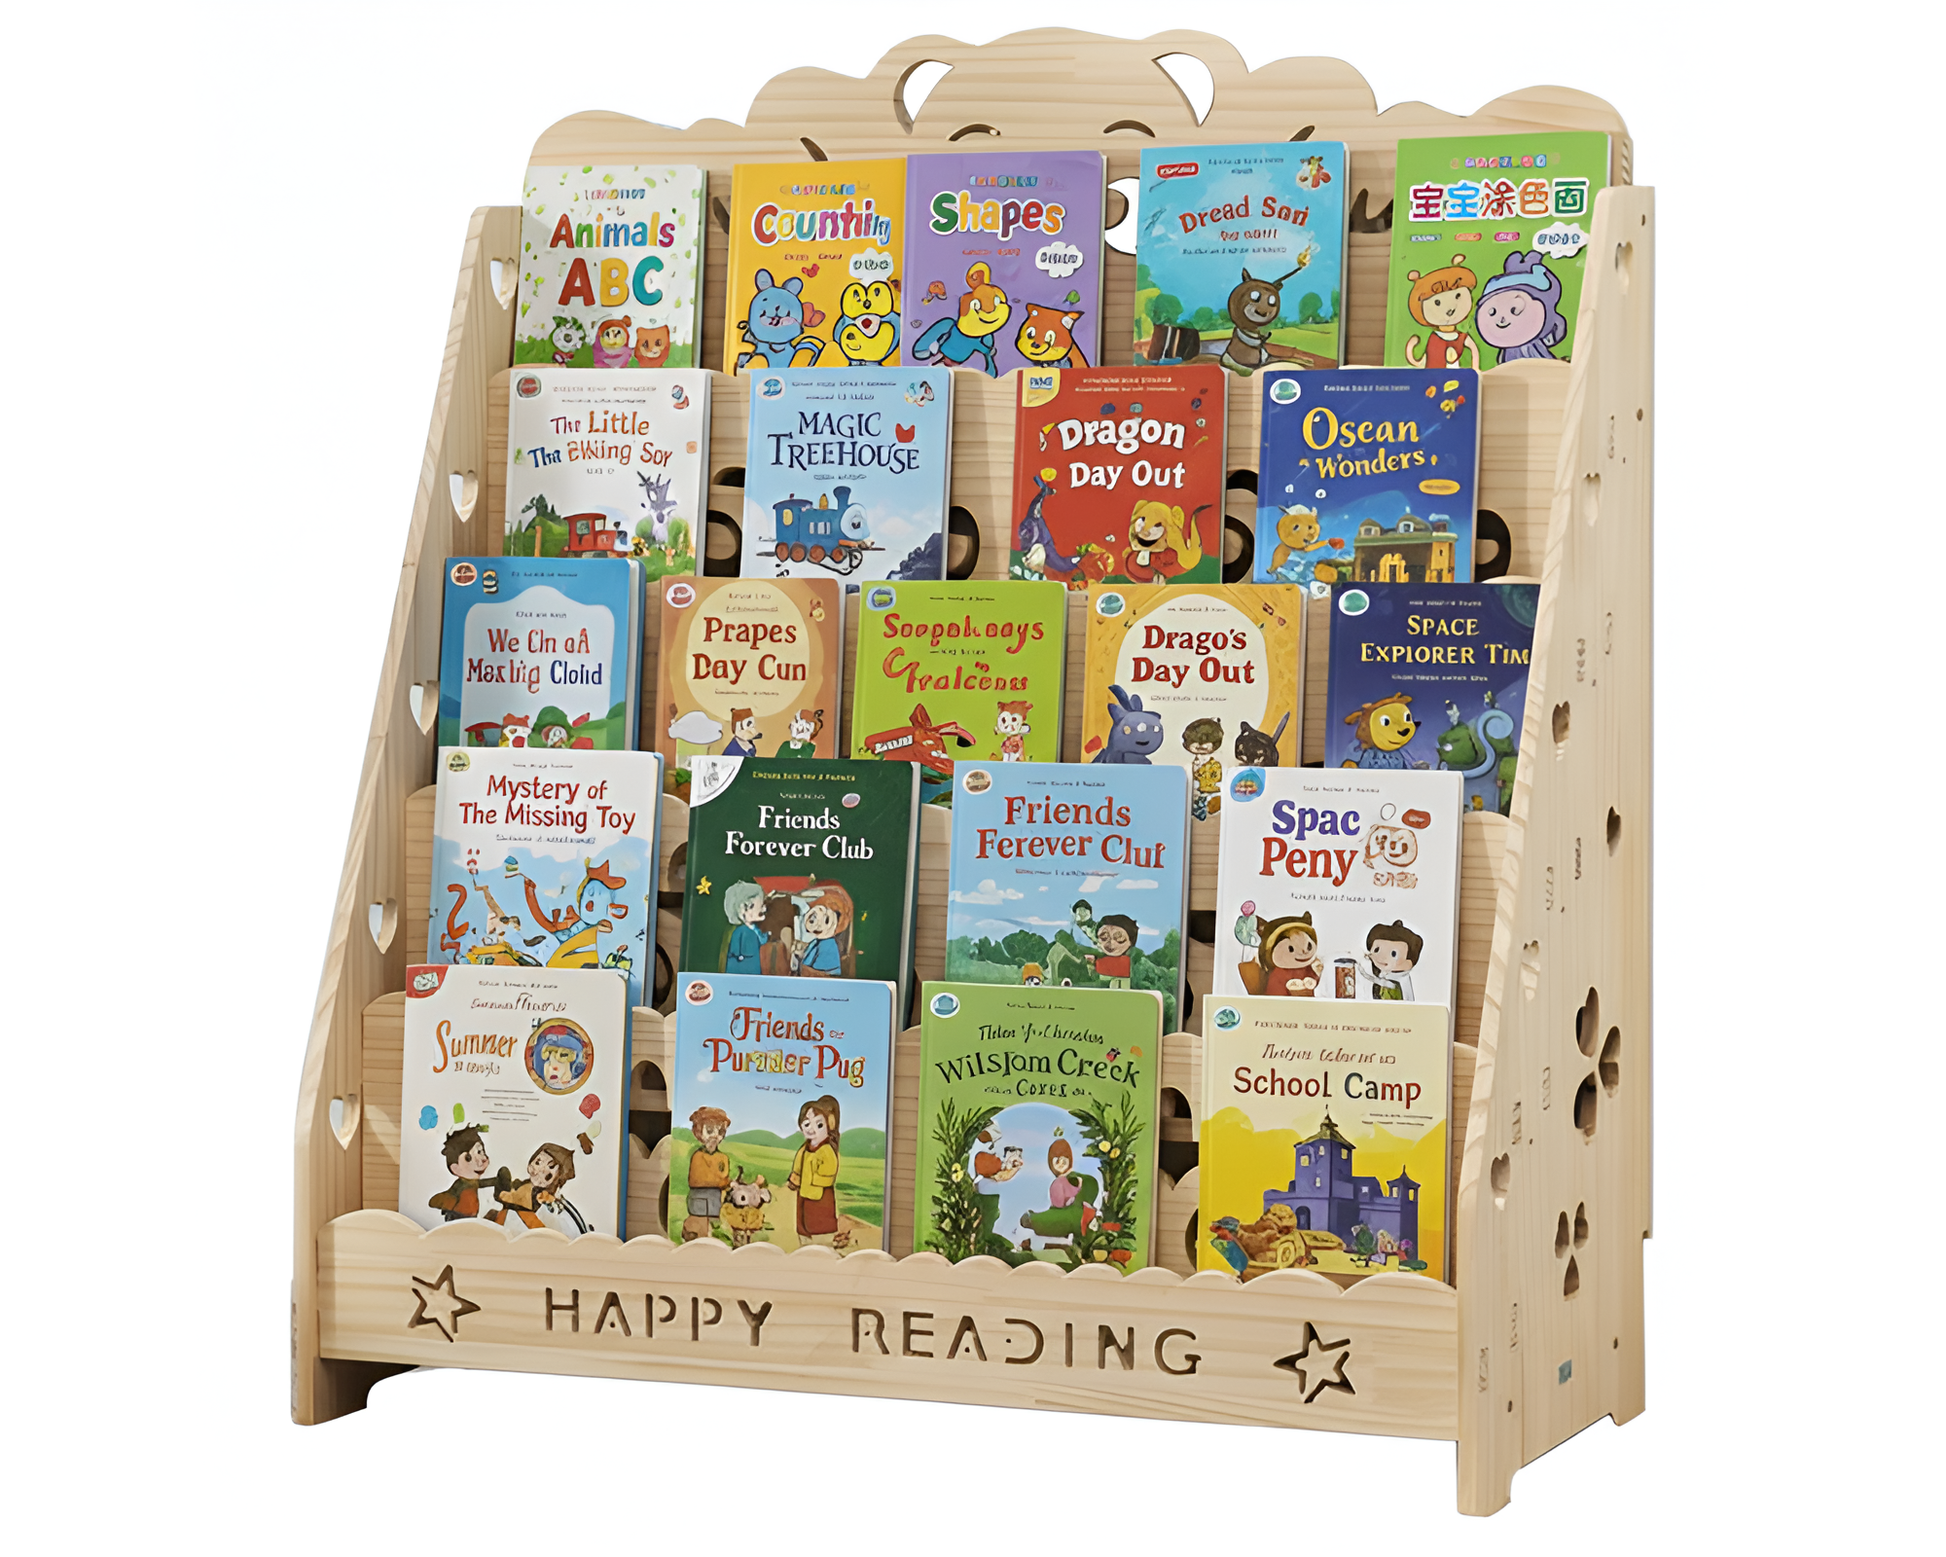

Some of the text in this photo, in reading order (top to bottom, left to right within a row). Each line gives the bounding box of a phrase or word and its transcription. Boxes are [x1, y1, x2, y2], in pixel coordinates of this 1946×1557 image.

[549, 211, 676, 248] Animals
[929, 190, 1067, 241] Shapes
[1178, 195, 1250, 234] Dread
[558, 255, 664, 307] ABC
[587, 409, 650, 436] Little
[798, 411, 882, 439] MAGIC
[1056, 417, 1186, 455] Dragon
[1302, 406, 1420, 450] Osean
[767, 432, 920, 474] TREEHOUSE
[1315, 448, 1426, 479] Wonders
[1069, 460, 1186, 490] Day Out
[487, 628, 520, 653] We
[703, 616, 797, 650] Prapes
[1142, 624, 1248, 656] Drago's
[1407, 615, 1480, 636] SPACE
[692, 653, 807, 685] Day Cun
[1131, 657, 1255, 688] Day Out
[486, 774, 609, 805] Mystery of
[459, 799, 636, 835] The Missing Toy
[757, 805, 841, 830] Friends
[1003, 795, 1132, 828] Friends
[1271, 799, 1361, 841] Spac
[724, 830, 874, 860] Forever Club
[1258, 837, 1360, 887] Peny
[729, 1006, 825, 1043] Friends
[812, 1044, 867, 1088] Pug
[1233, 1066, 1422, 1110] School Camp
[545, 1286, 1203, 1376] HAPPY READING
